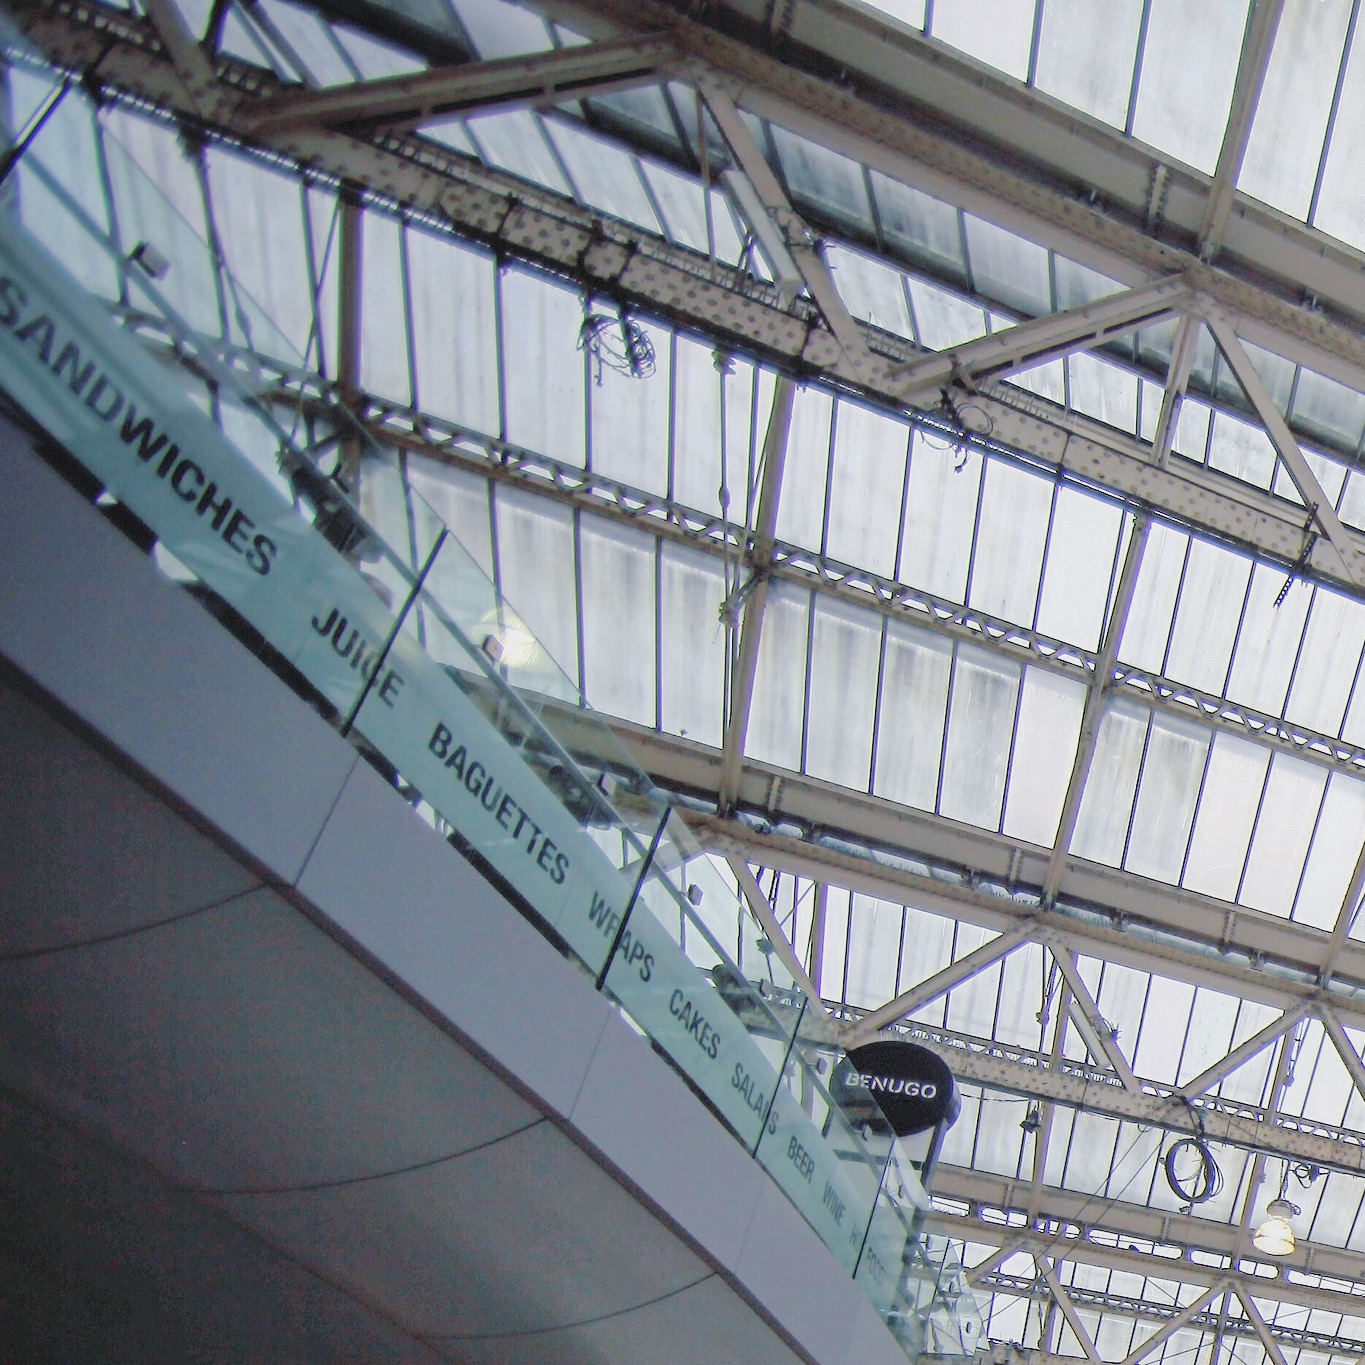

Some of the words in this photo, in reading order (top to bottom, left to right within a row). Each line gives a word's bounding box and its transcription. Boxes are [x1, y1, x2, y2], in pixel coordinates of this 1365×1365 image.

[0, 277, 277, 576] SANDWICHES
[428, 721, 570, 886] BAGUETTES
[669, 988, 721, 1060] CAKES
[731, 1062, 779, 1136] SALAS
[844, 1071, 938, 1100] BENUGO
[787, 1134, 816, 1184] BEER
[822, 1180, 846, 1228] WINE
